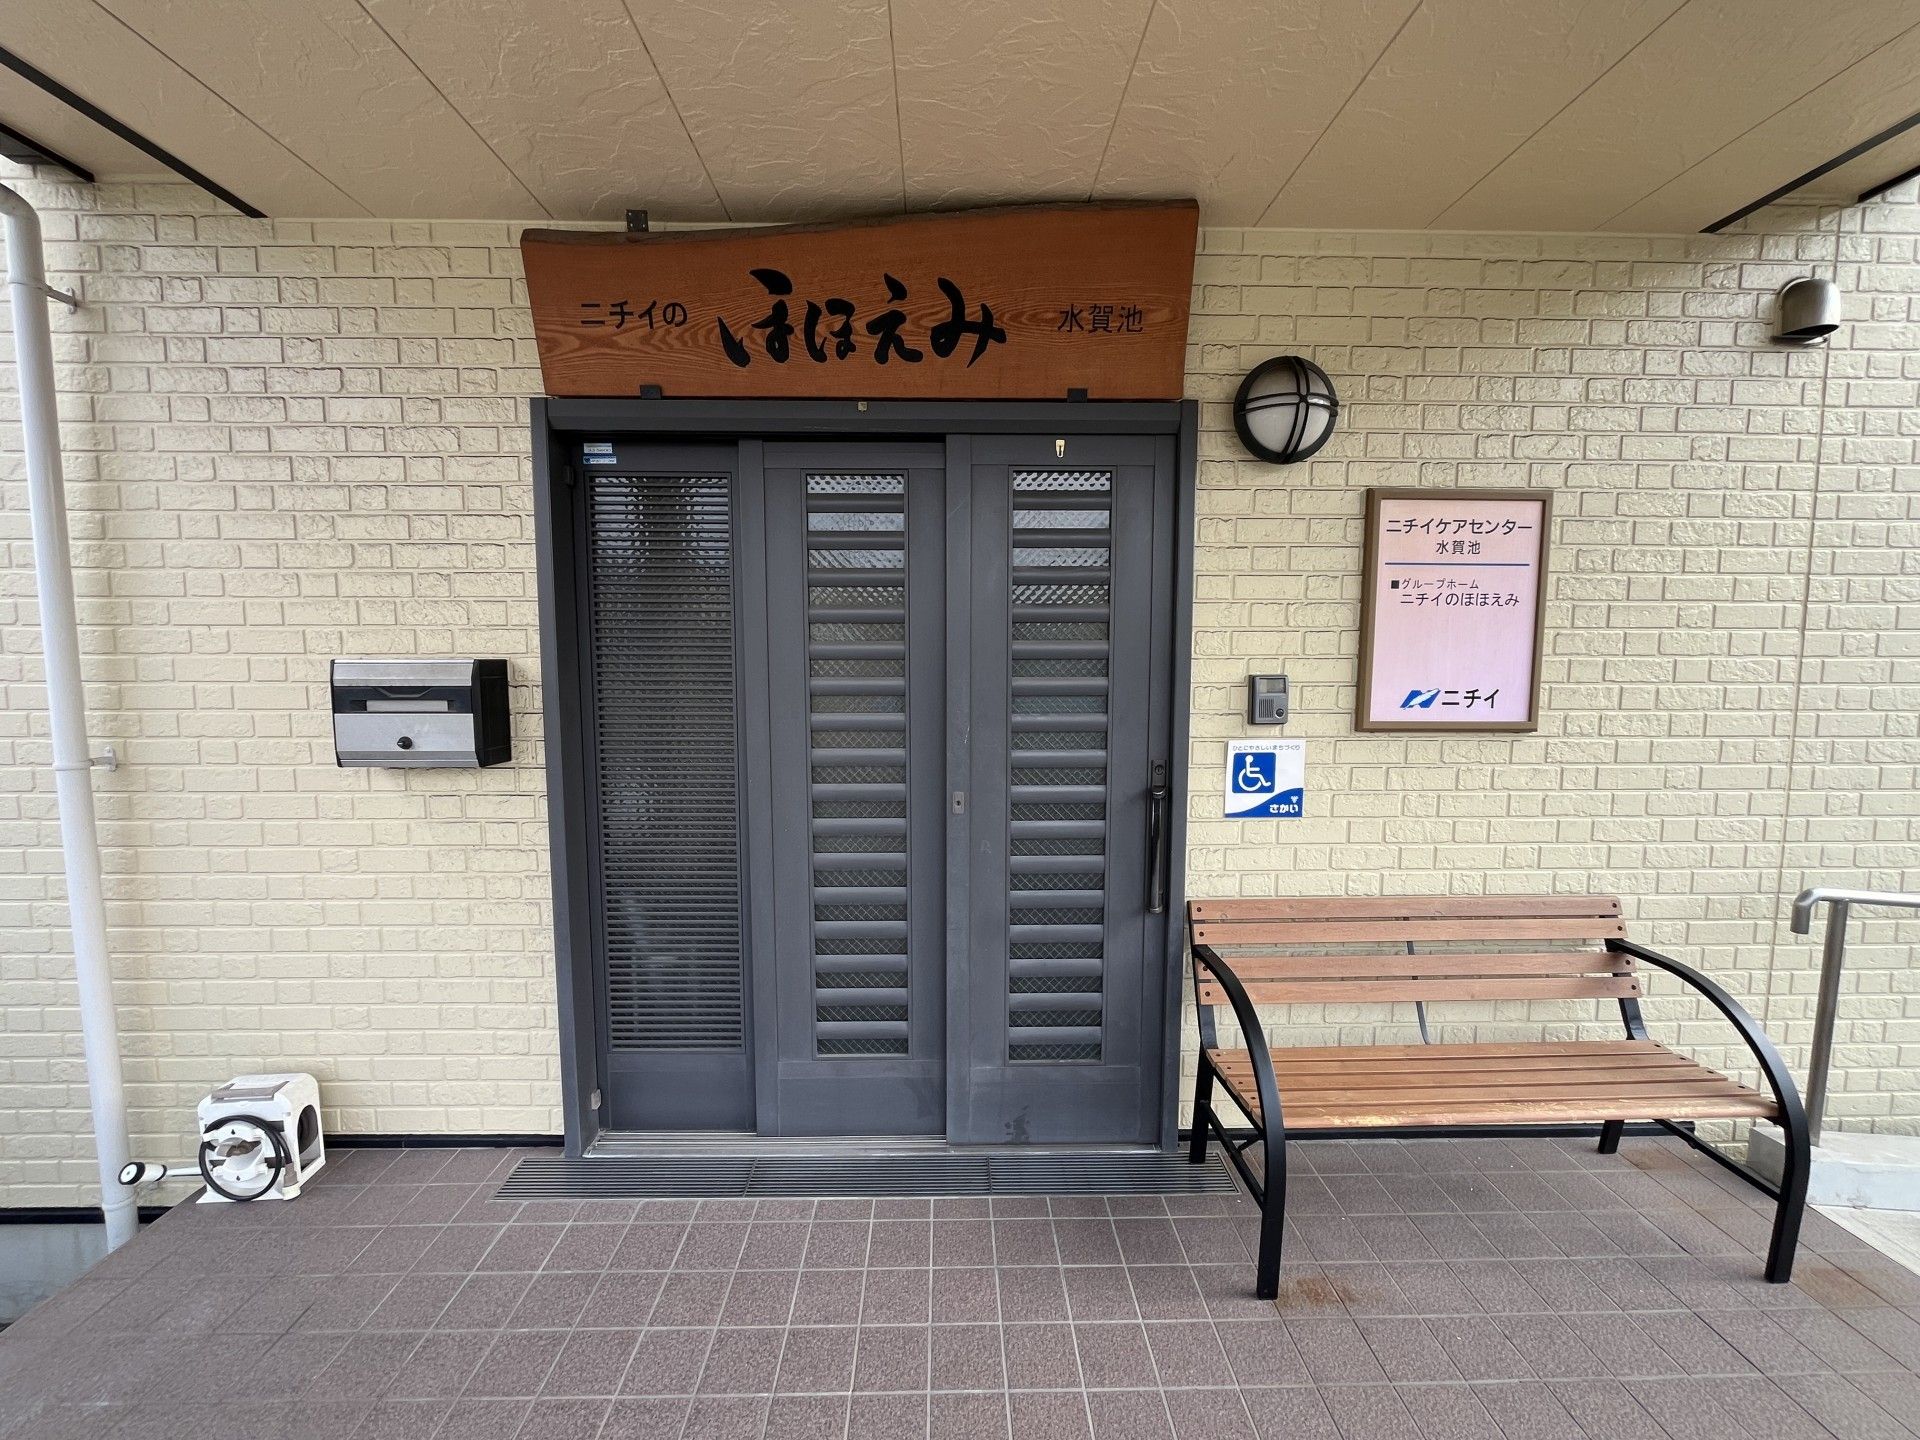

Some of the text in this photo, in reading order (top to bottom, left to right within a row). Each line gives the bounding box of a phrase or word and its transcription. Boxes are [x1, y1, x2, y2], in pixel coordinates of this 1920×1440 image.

[580, 268, 1143, 368] ニチイの ほほえみ 水賀池
[1386, 518, 1532, 536] ニチイケアセンター
[1435, 540, 1481, 555] 水賀池
[1400, 592, 1520, 608] ニチイのほほえみ
[1441, 688, 1500, 709] ニチイ
[1269, 804, 1299, 813] さかい
